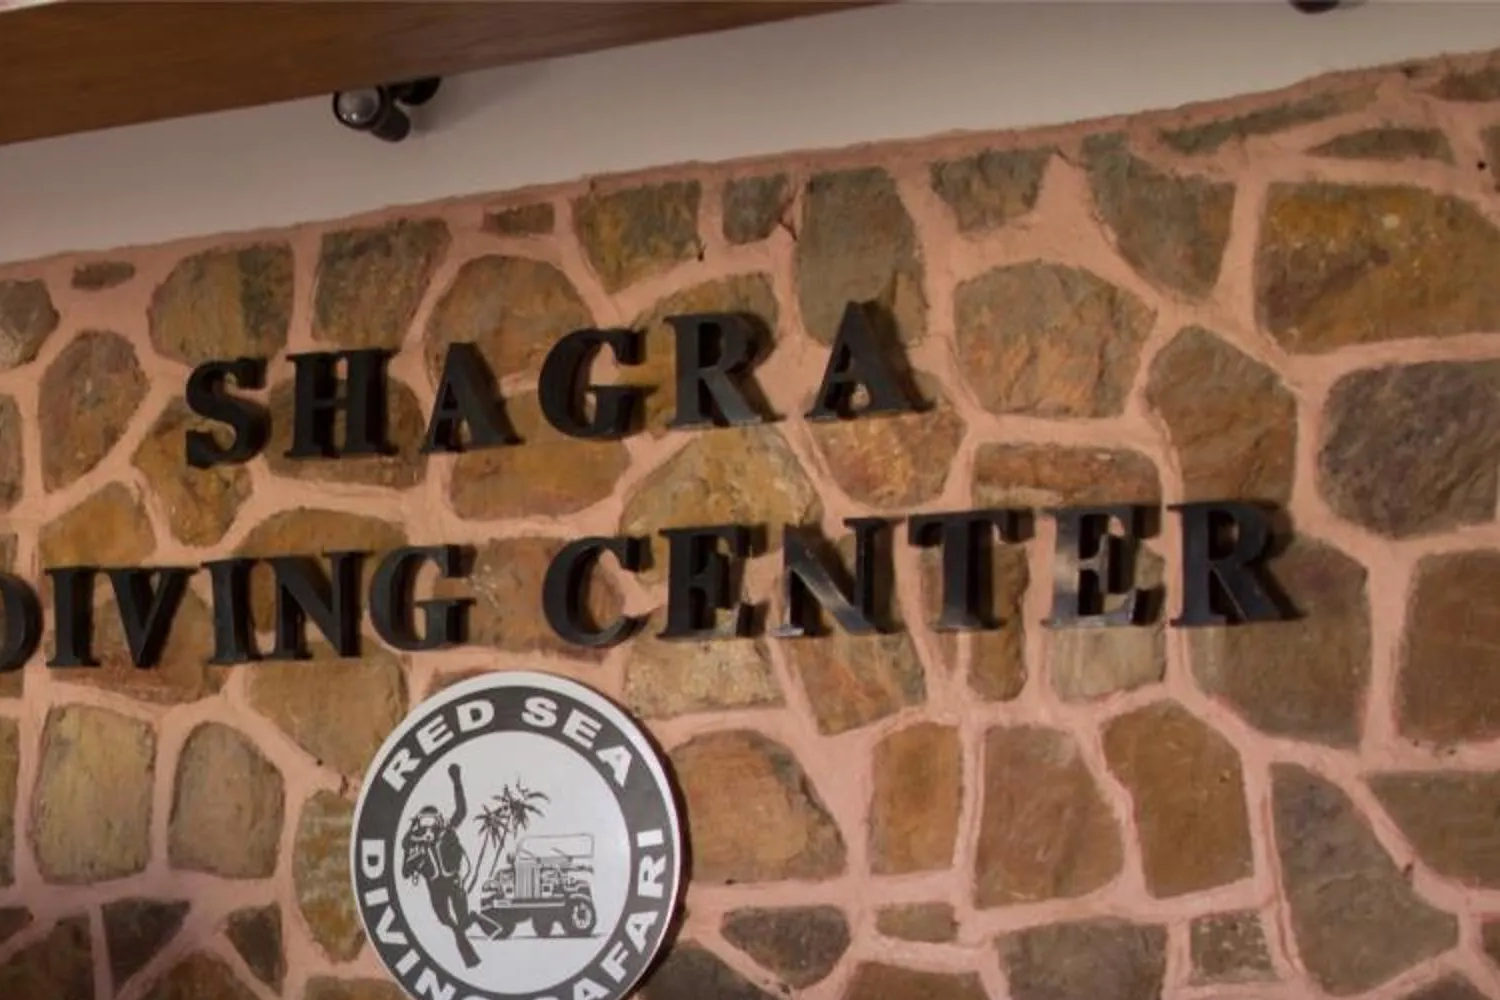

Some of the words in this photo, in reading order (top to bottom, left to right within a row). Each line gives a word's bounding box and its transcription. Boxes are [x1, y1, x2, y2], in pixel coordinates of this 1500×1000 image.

[184, 300, 936, 469] SHAGRA
[541, 502, 1305, 648] CENTER
[381, 699, 496, 792] RED
[520, 696, 634, 788] SEA
